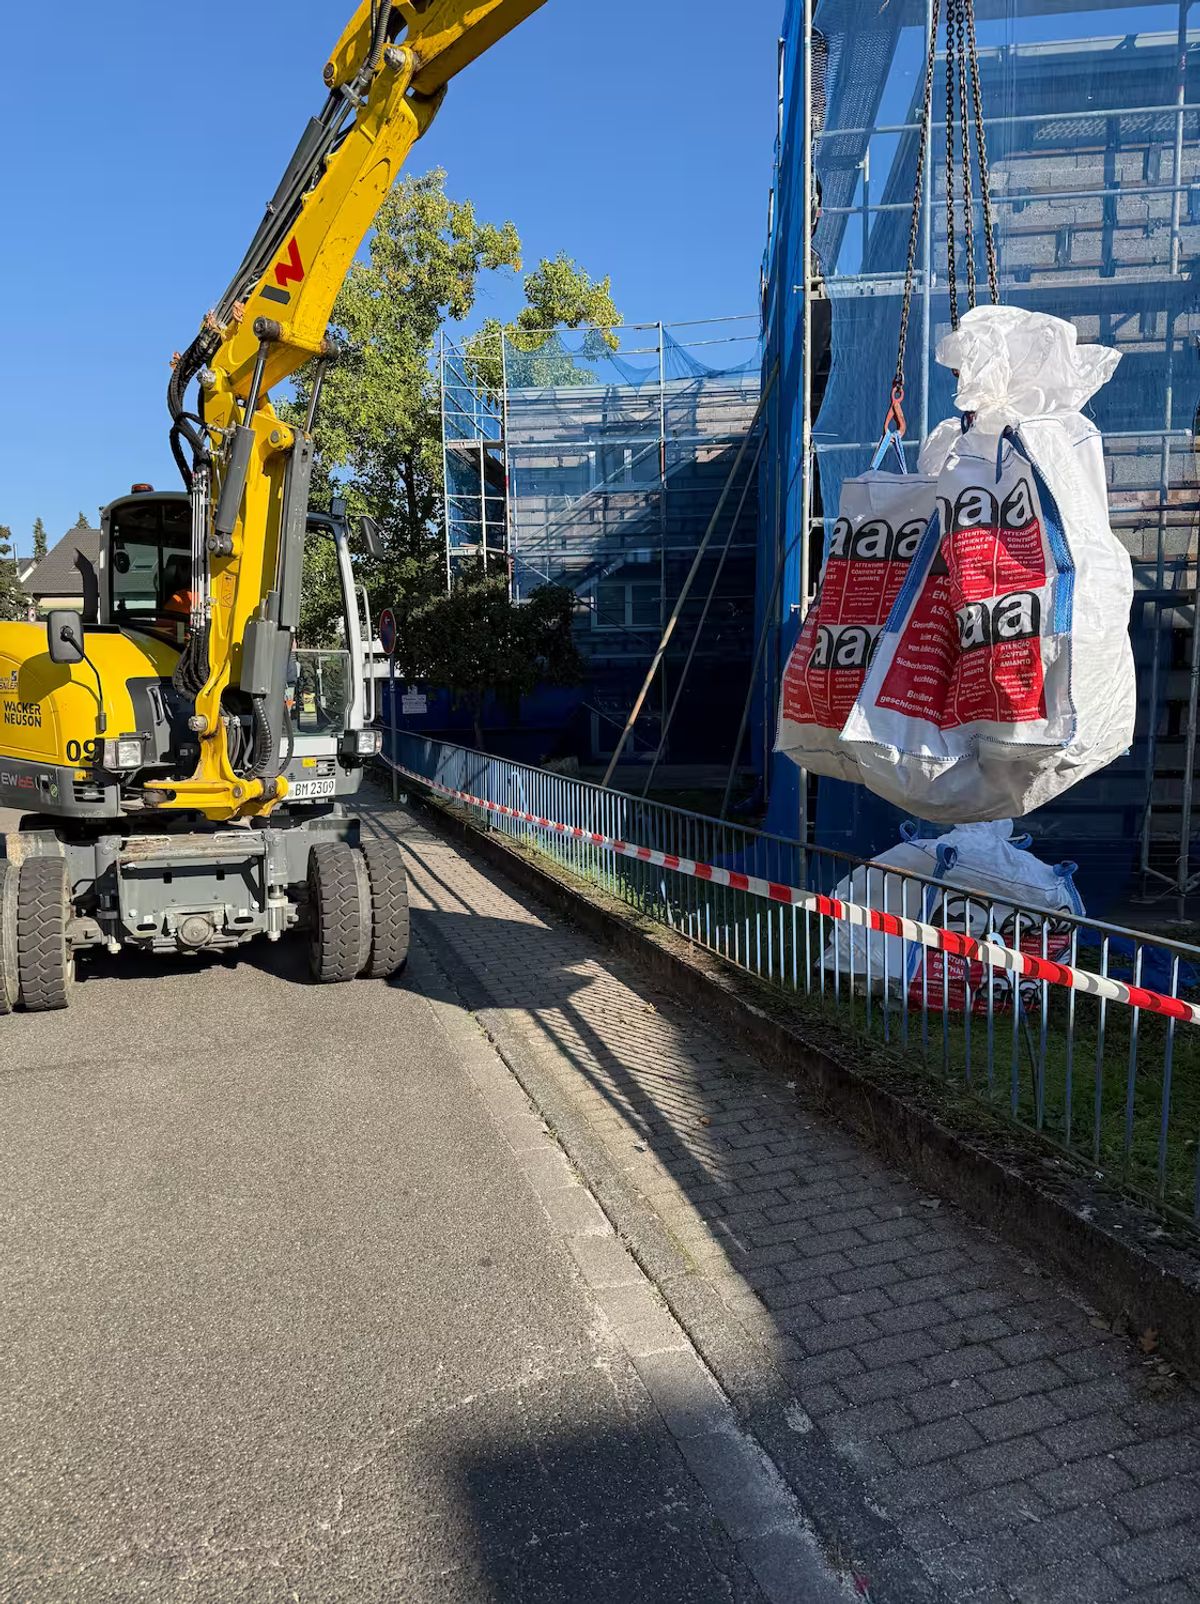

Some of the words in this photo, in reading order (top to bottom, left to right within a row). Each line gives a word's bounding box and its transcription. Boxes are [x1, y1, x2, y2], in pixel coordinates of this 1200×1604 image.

[3, 701, 41, 715] WACKER
[4, 713, 42, 728] NEUSON
[295, 783, 309, 796] BM
[310, 780, 334, 795] 2309
